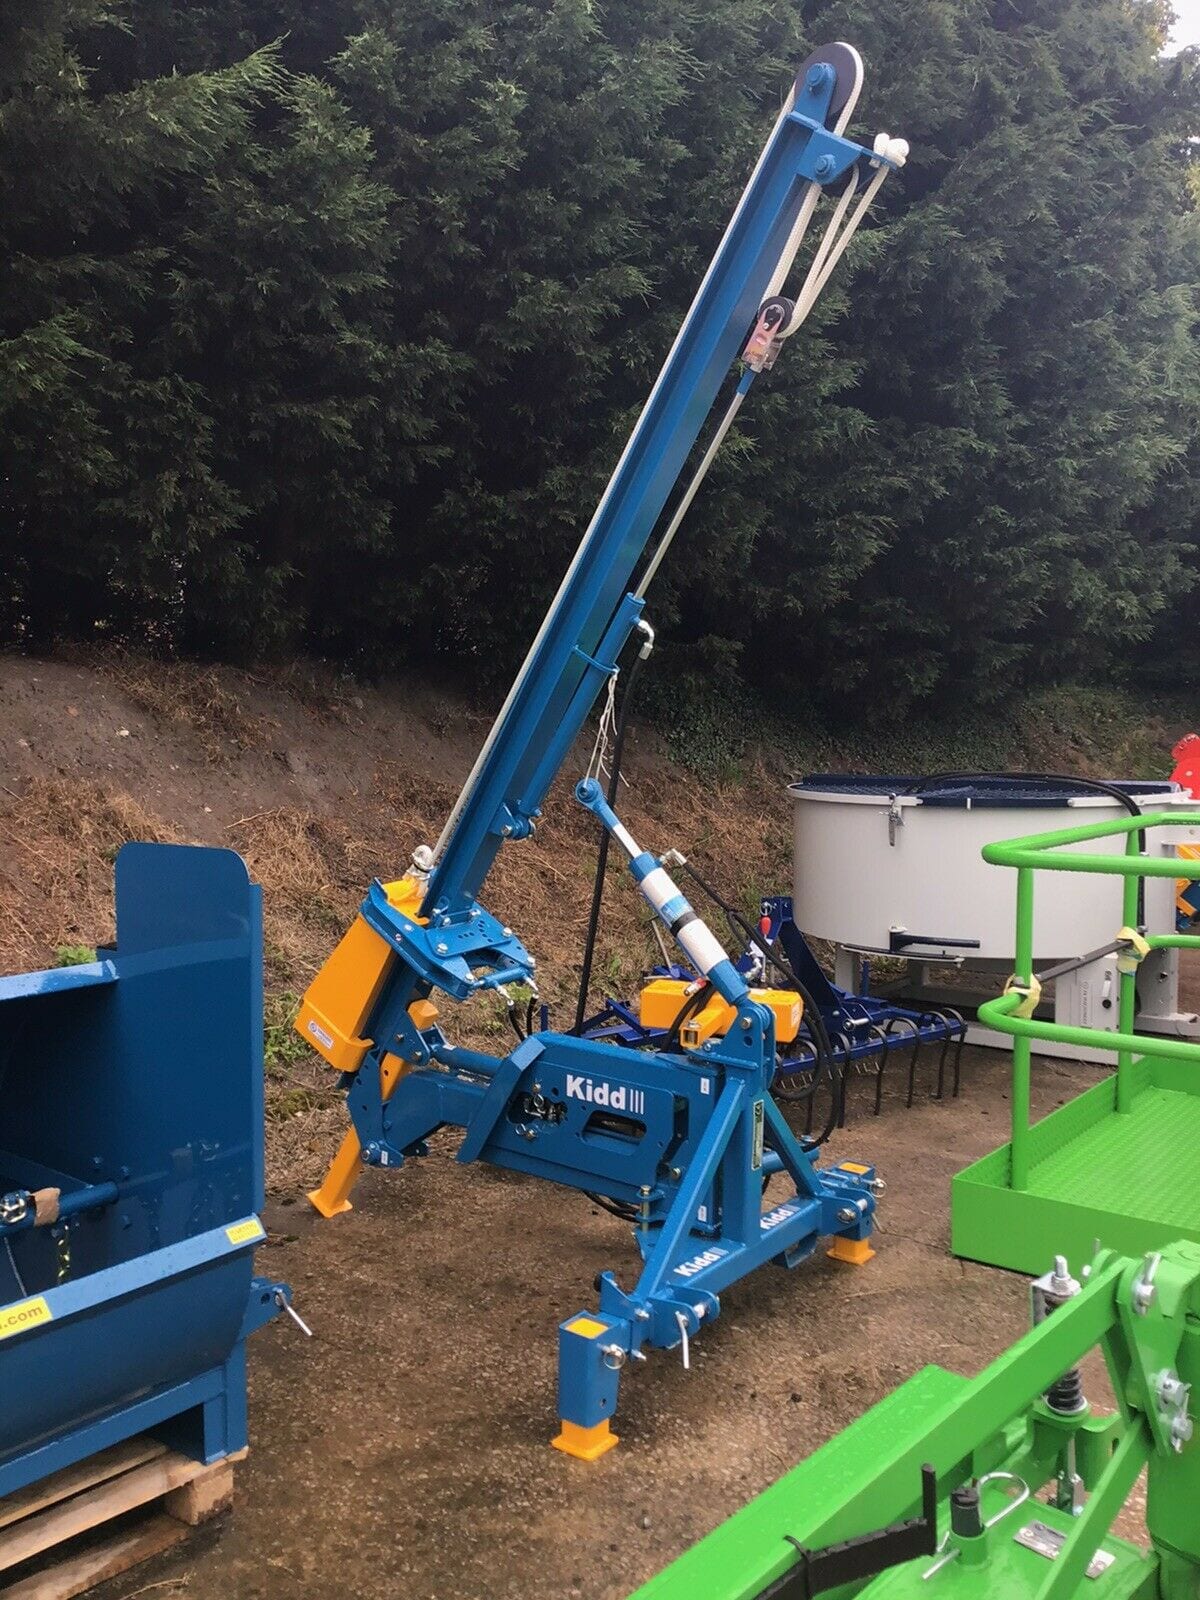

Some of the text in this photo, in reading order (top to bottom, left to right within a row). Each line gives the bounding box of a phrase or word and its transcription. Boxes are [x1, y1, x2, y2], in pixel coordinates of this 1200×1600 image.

[566, 1074, 626, 1111] Kidd
[760, 1208, 795, 1230] Kidd
[673, 1251, 721, 1277] Kidd
[0, 1306, 43, 1329] .com
